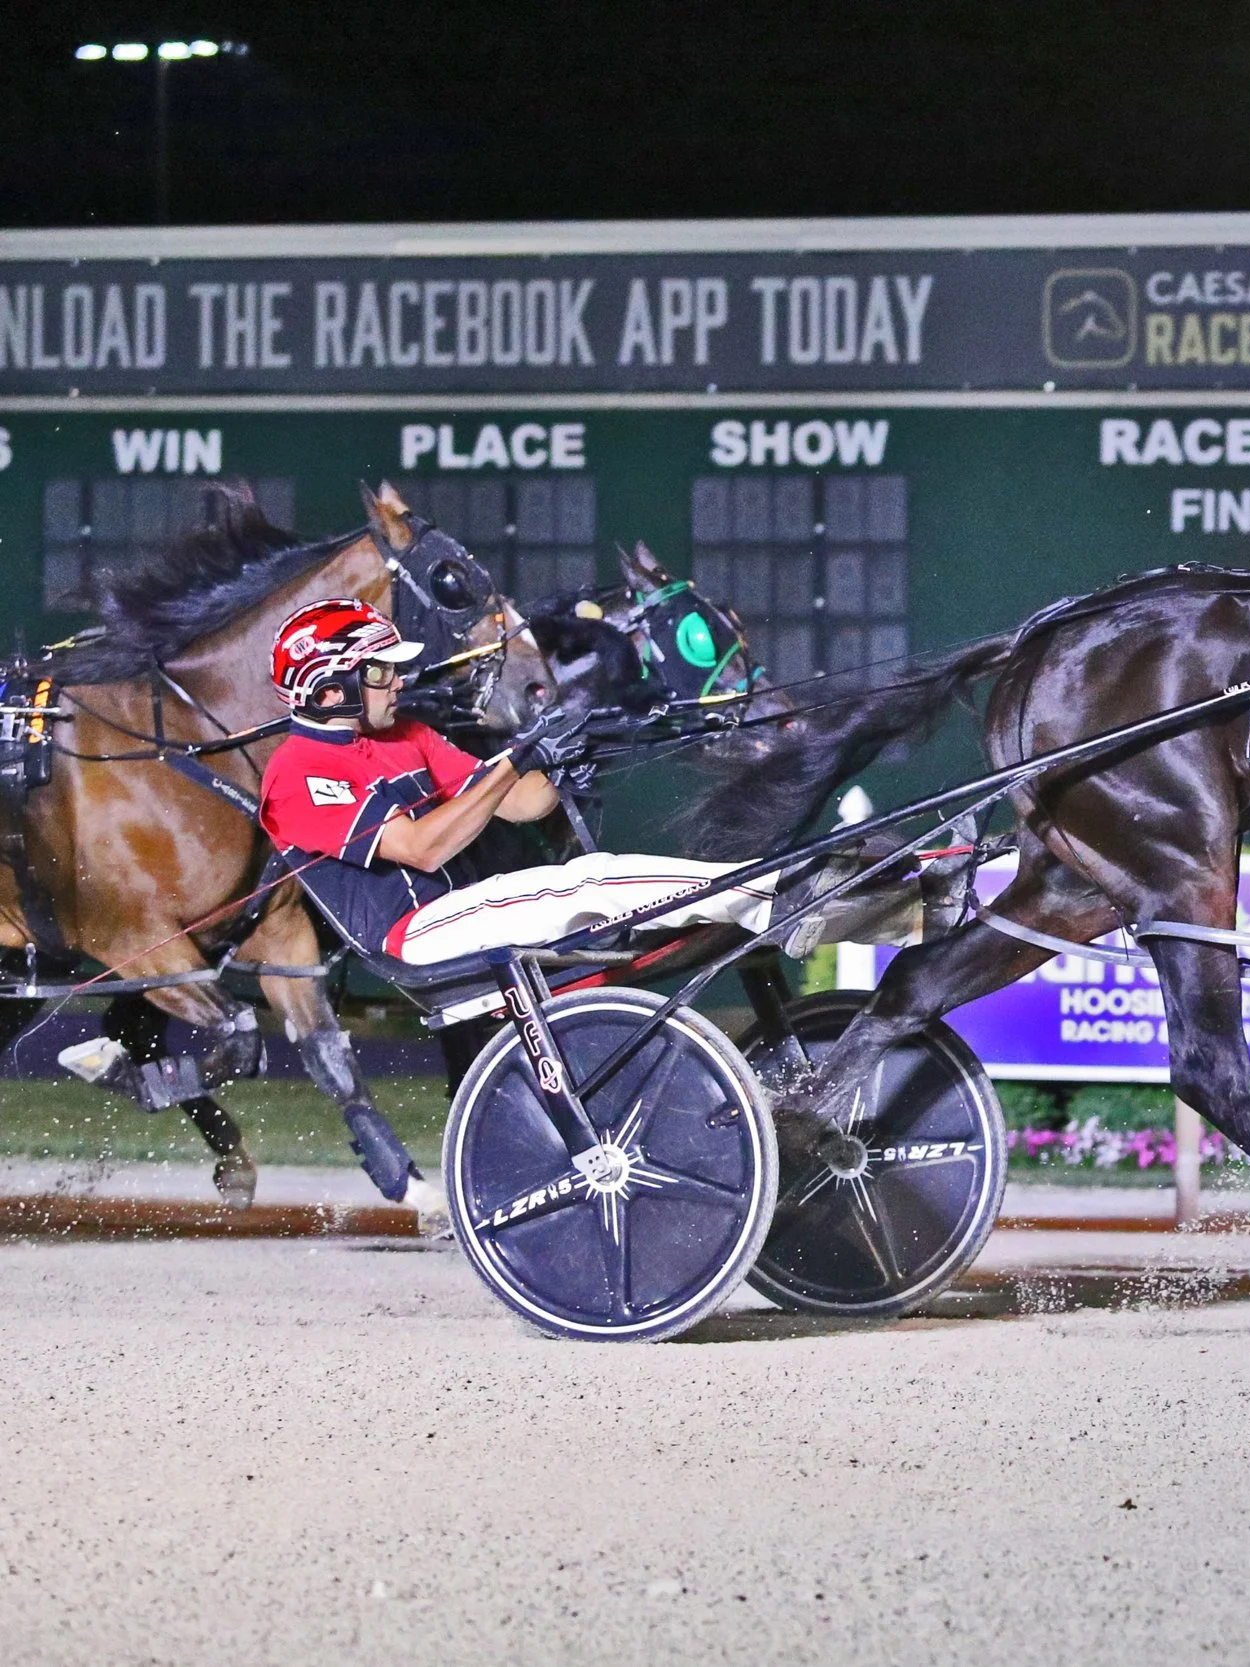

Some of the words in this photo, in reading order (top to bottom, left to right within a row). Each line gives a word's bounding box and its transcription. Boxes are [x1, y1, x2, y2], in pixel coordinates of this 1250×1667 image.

[0, 283, 166, 369] NLOAD
[189, 282, 292, 368] THE
[313, 279, 594, 368] RACEBOOK
[618, 278, 728, 366] APP
[751, 275, 934, 365] TODAY
[112, 428, 222, 474] WIN
[401, 423, 586, 470] PLACE
[710, 420, 889, 466] SHOW
[1060, 987, 1165, 1017] HOOSI
[1060, 1020, 1154, 1045] RACING
